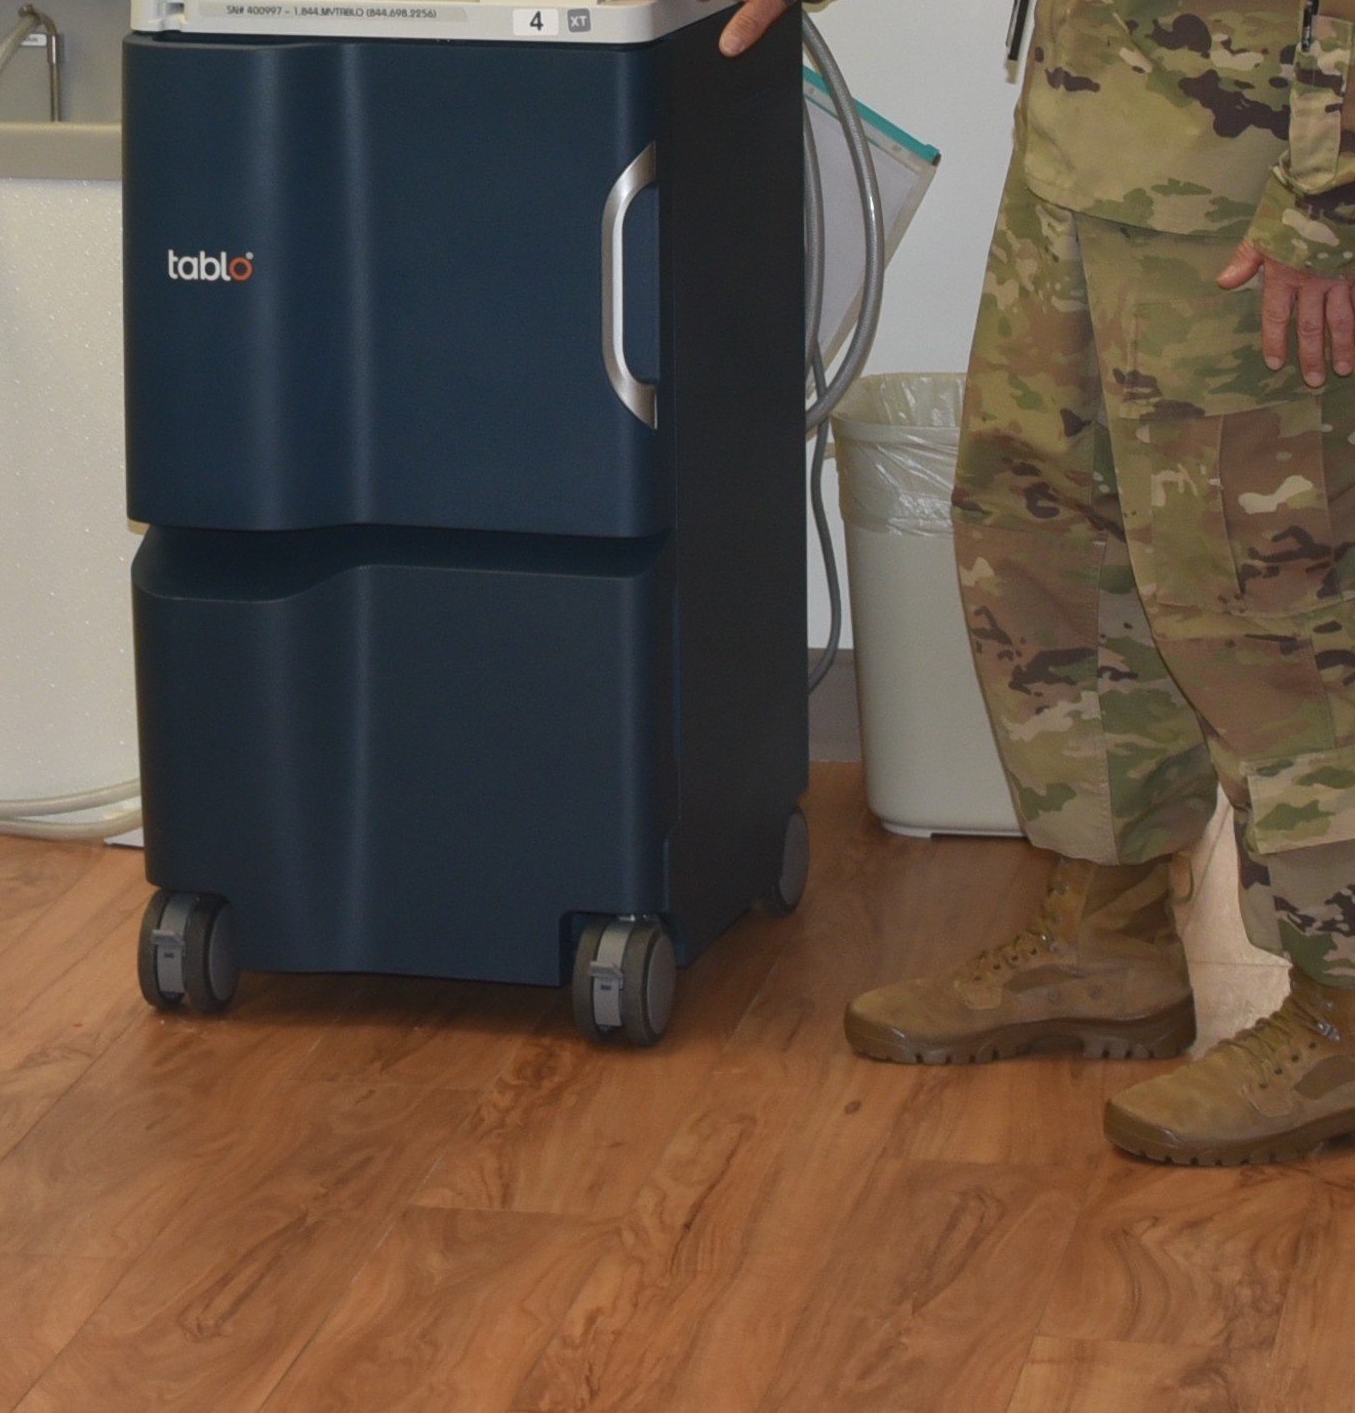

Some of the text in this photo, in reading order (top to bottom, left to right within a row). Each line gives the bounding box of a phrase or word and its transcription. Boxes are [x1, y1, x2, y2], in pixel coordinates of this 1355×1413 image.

[226, 5, 244, 15] SN#
[530, 10, 544, 31] 4
[570, 15, 587, 27] XT
[168, 249, 254, 281] tablo
